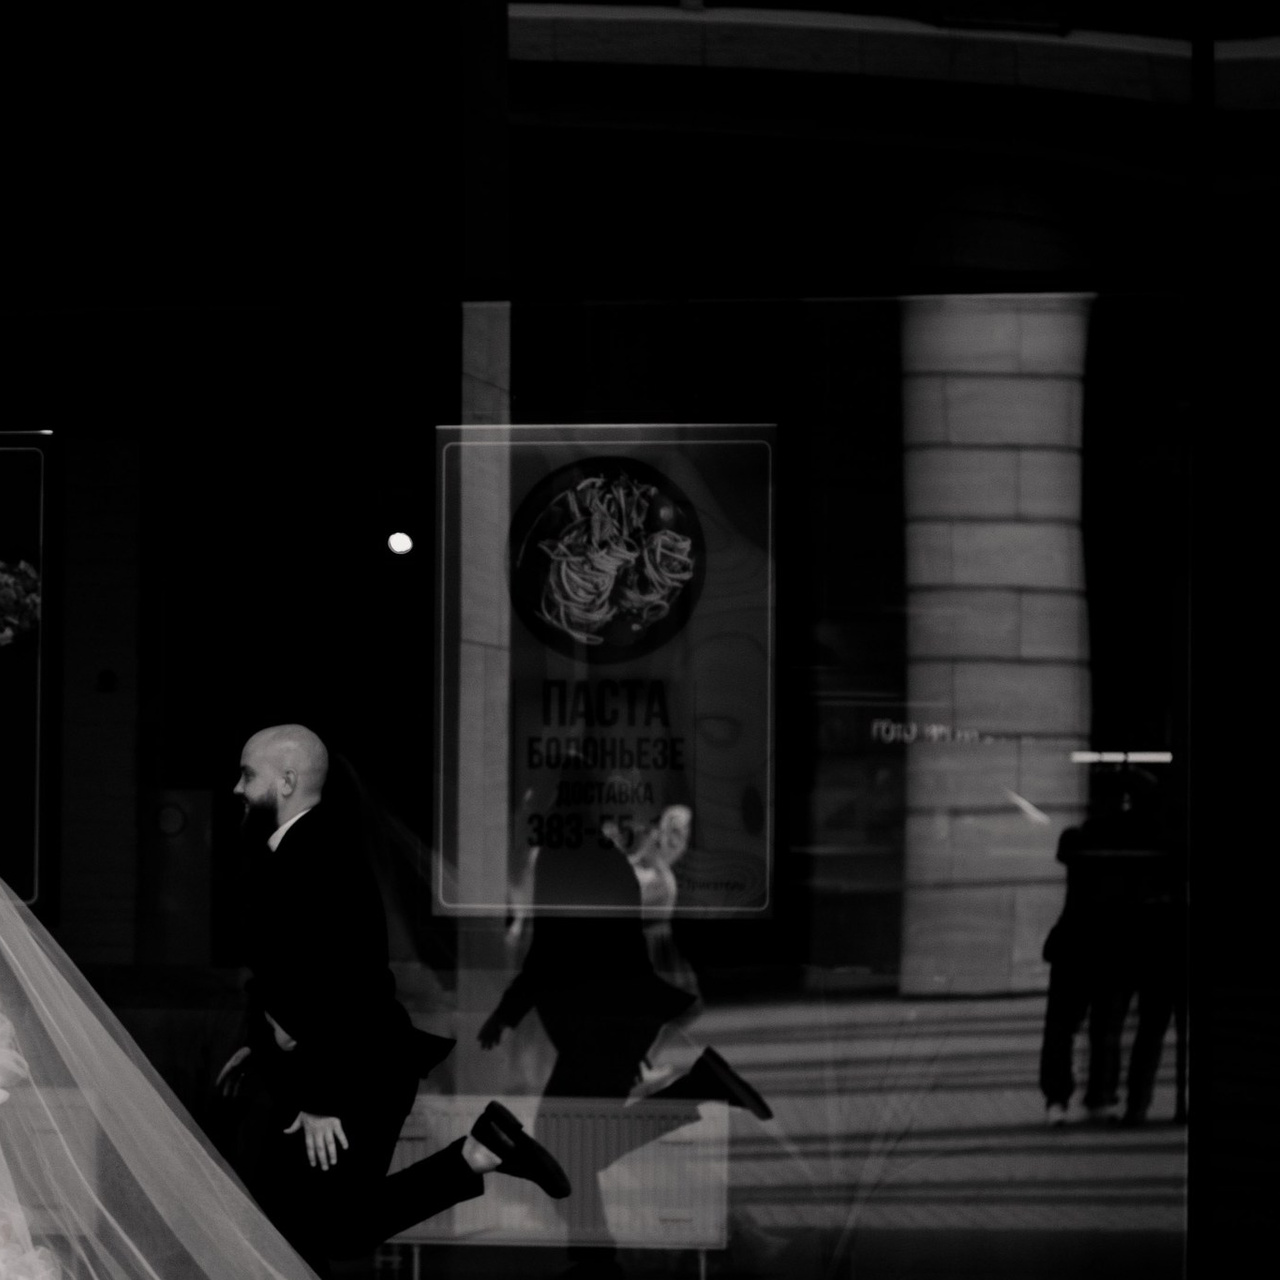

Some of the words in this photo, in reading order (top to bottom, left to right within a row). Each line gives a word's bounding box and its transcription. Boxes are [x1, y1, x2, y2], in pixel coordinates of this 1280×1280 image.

[542, 678, 671, 727] ПАСТА
[527, 736, 685, 771] БОЛОНЬЕЗЕ
[556, 780, 654, 808] ДОСТАВКА
